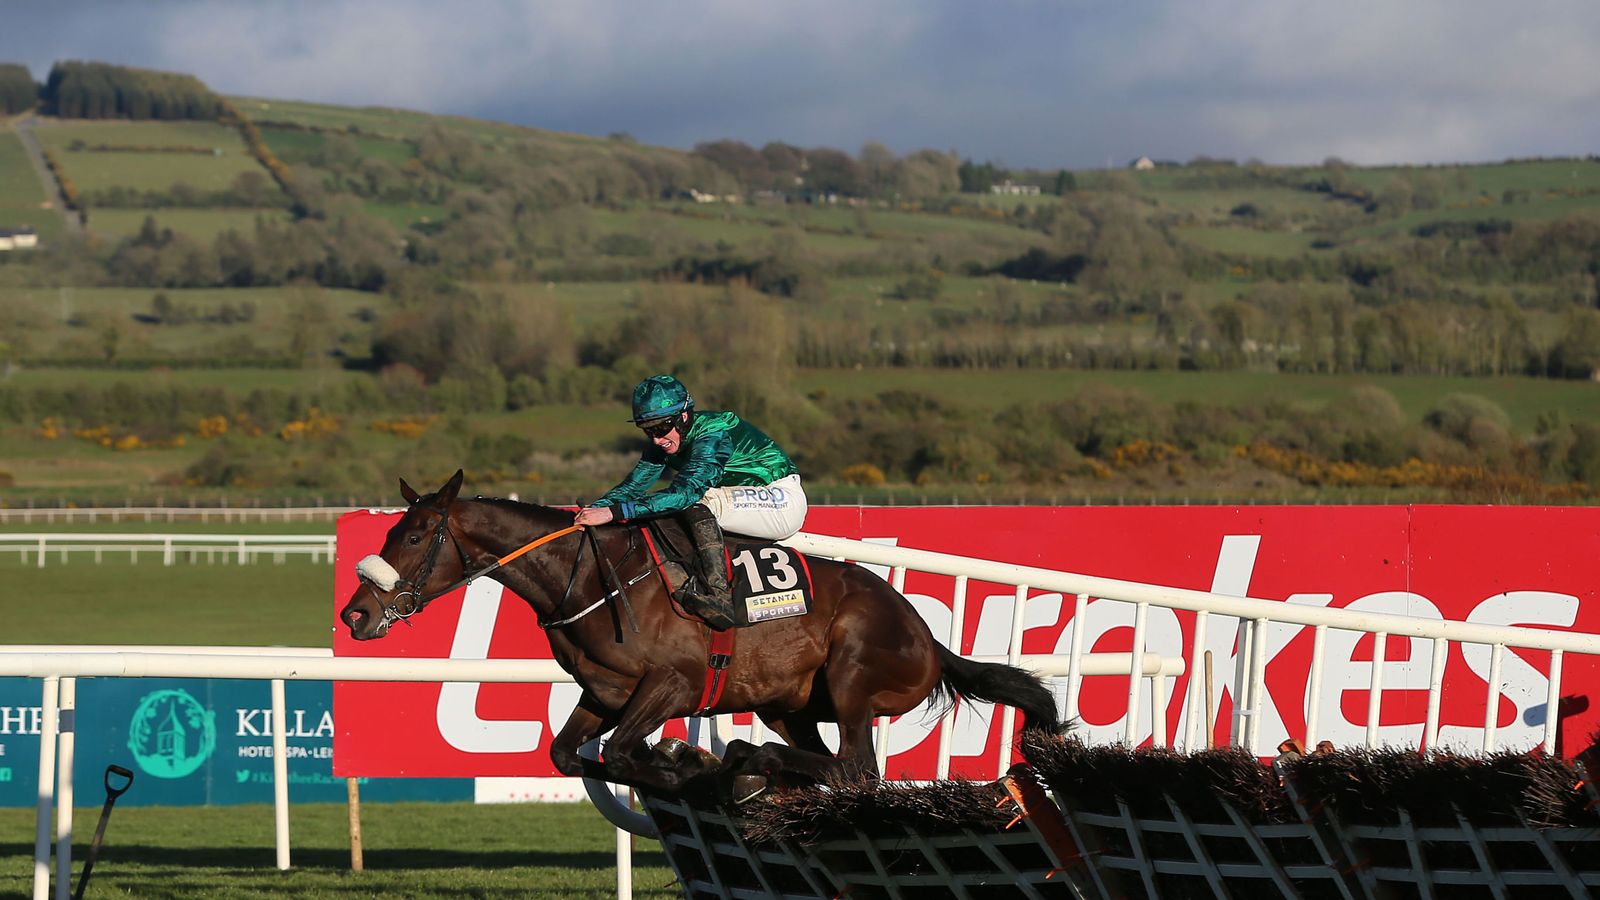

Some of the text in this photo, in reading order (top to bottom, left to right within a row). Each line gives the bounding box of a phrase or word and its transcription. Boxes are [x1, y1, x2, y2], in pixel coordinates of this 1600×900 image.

[731, 547, 798, 593] 13
[752, 593, 797, 606] SETANTA
[754, 605, 801, 618] SPORTS
[436, 534, 1580, 757] Lrokes
[238, 745, 274, 757] HOTE
